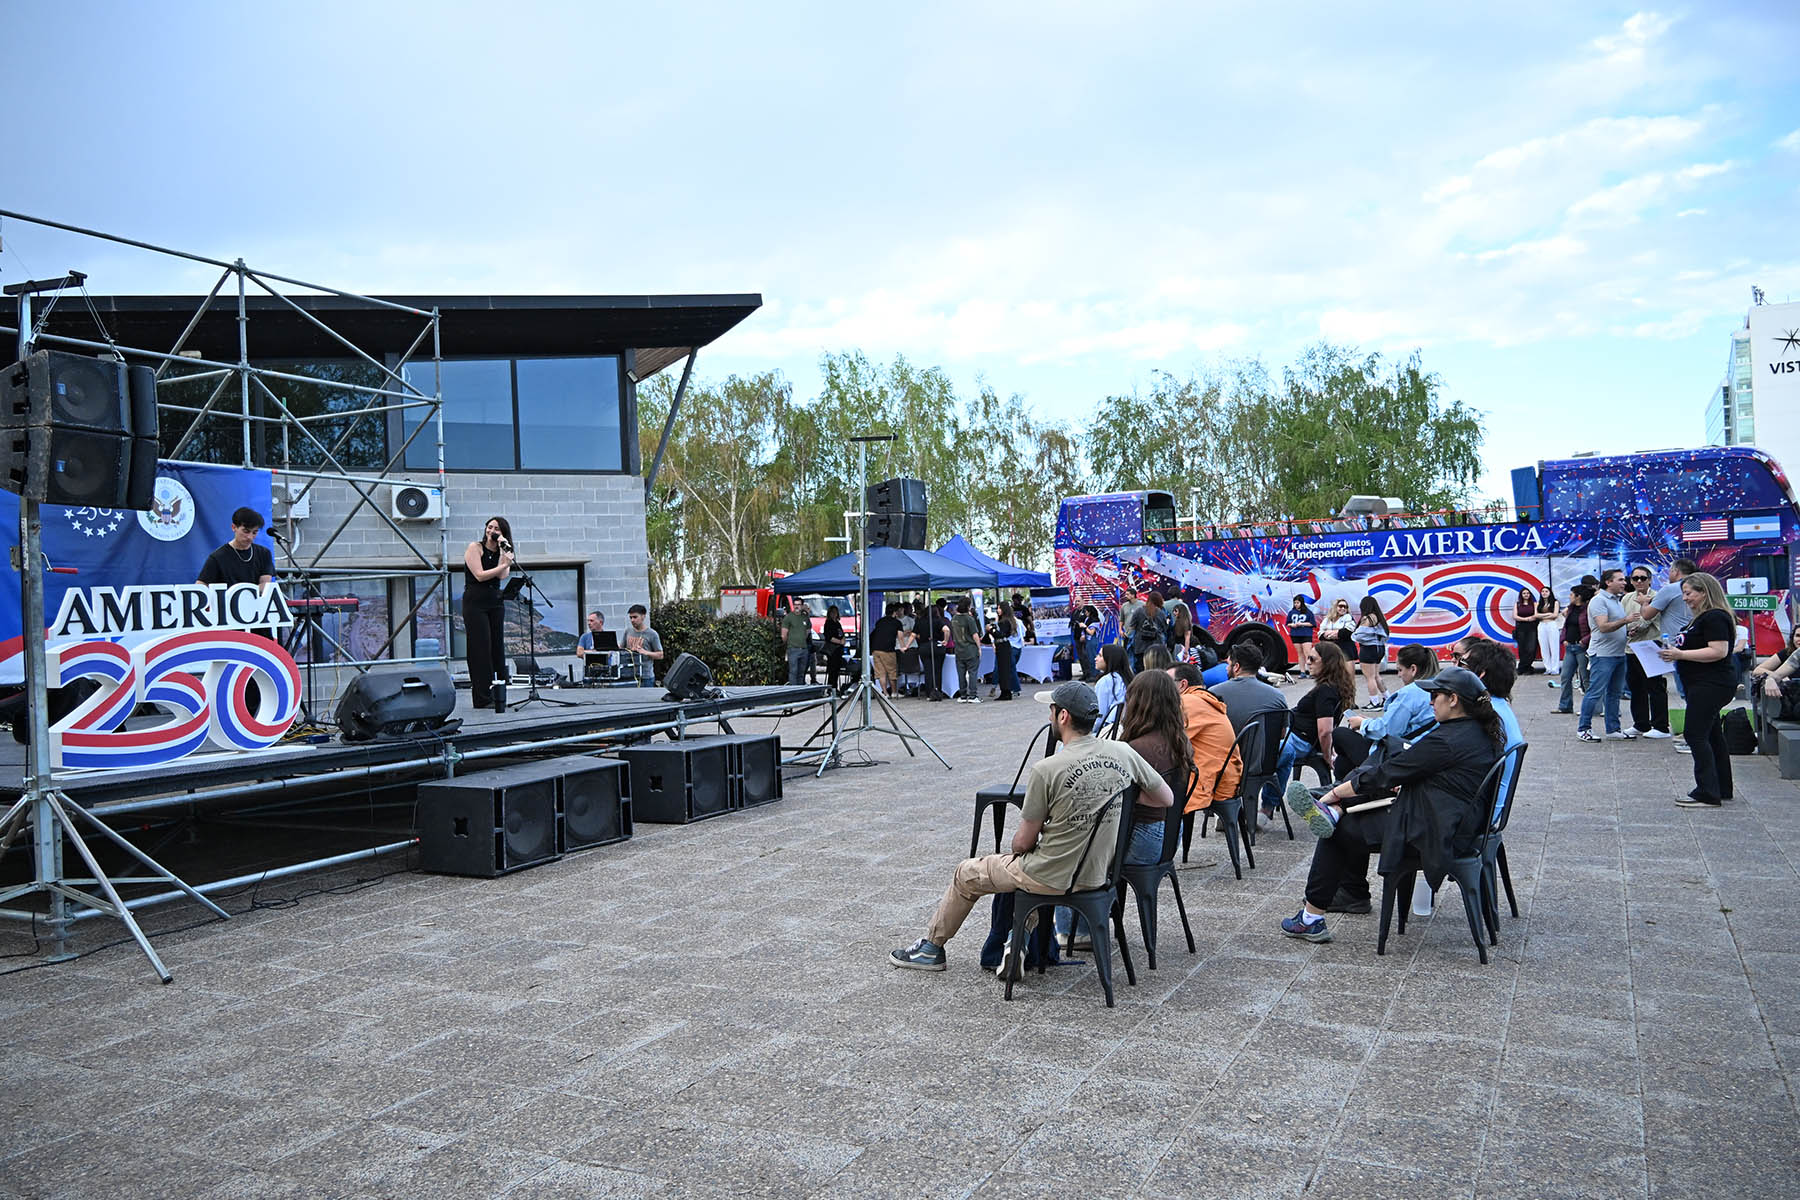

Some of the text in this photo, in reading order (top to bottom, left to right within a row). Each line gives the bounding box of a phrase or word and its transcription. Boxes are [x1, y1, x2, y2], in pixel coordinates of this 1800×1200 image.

[1285, 546, 1374, 560] la Independencia!
[1343, 539, 1371, 549] juntos
[1379, 526, 1547, 558] AMERICA
[58, 587, 292, 637] AMERICA
[1368, 564, 1546, 646] 250
[1734, 597, 1769, 608] 250 AÑOS
[47, 630, 302, 768] 250
[1064, 760, 1131, 790] WHO EVEN CARES?
